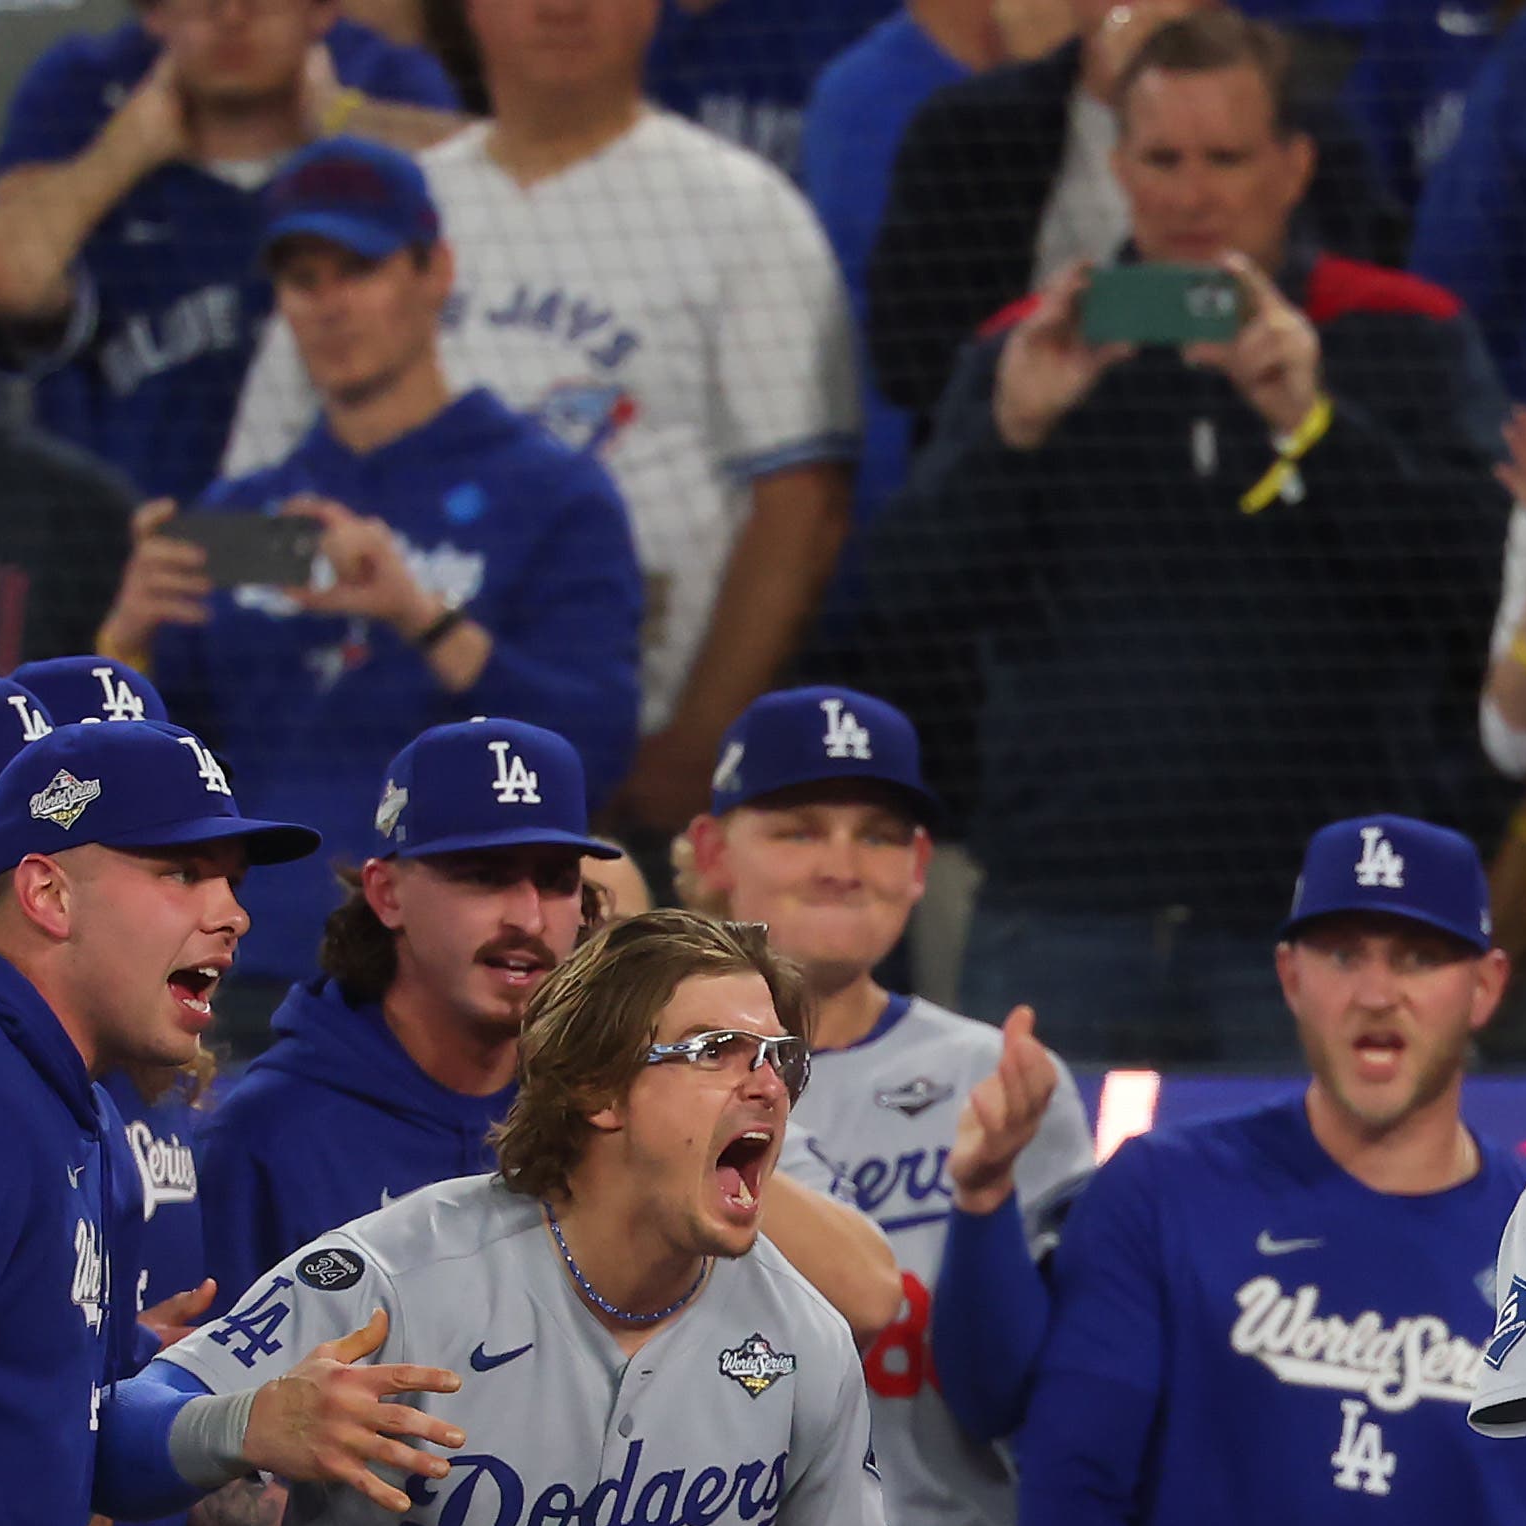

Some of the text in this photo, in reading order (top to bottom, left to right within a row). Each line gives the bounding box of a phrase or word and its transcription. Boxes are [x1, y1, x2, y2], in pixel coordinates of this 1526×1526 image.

[485, 280, 641, 368] JAYS
[91, 667, 146, 720] LA
[821, 699, 871, 759] LA
[178, 737, 232, 795] LA
[487, 740, 542, 803] LA
[1353, 825, 1405, 888] LA
[304, 1257, 348, 1285] 34
[207, 1276, 295, 1368] LA
[1230, 1275, 1405, 1390] World
[1331, 1399, 1397, 1496] LA
